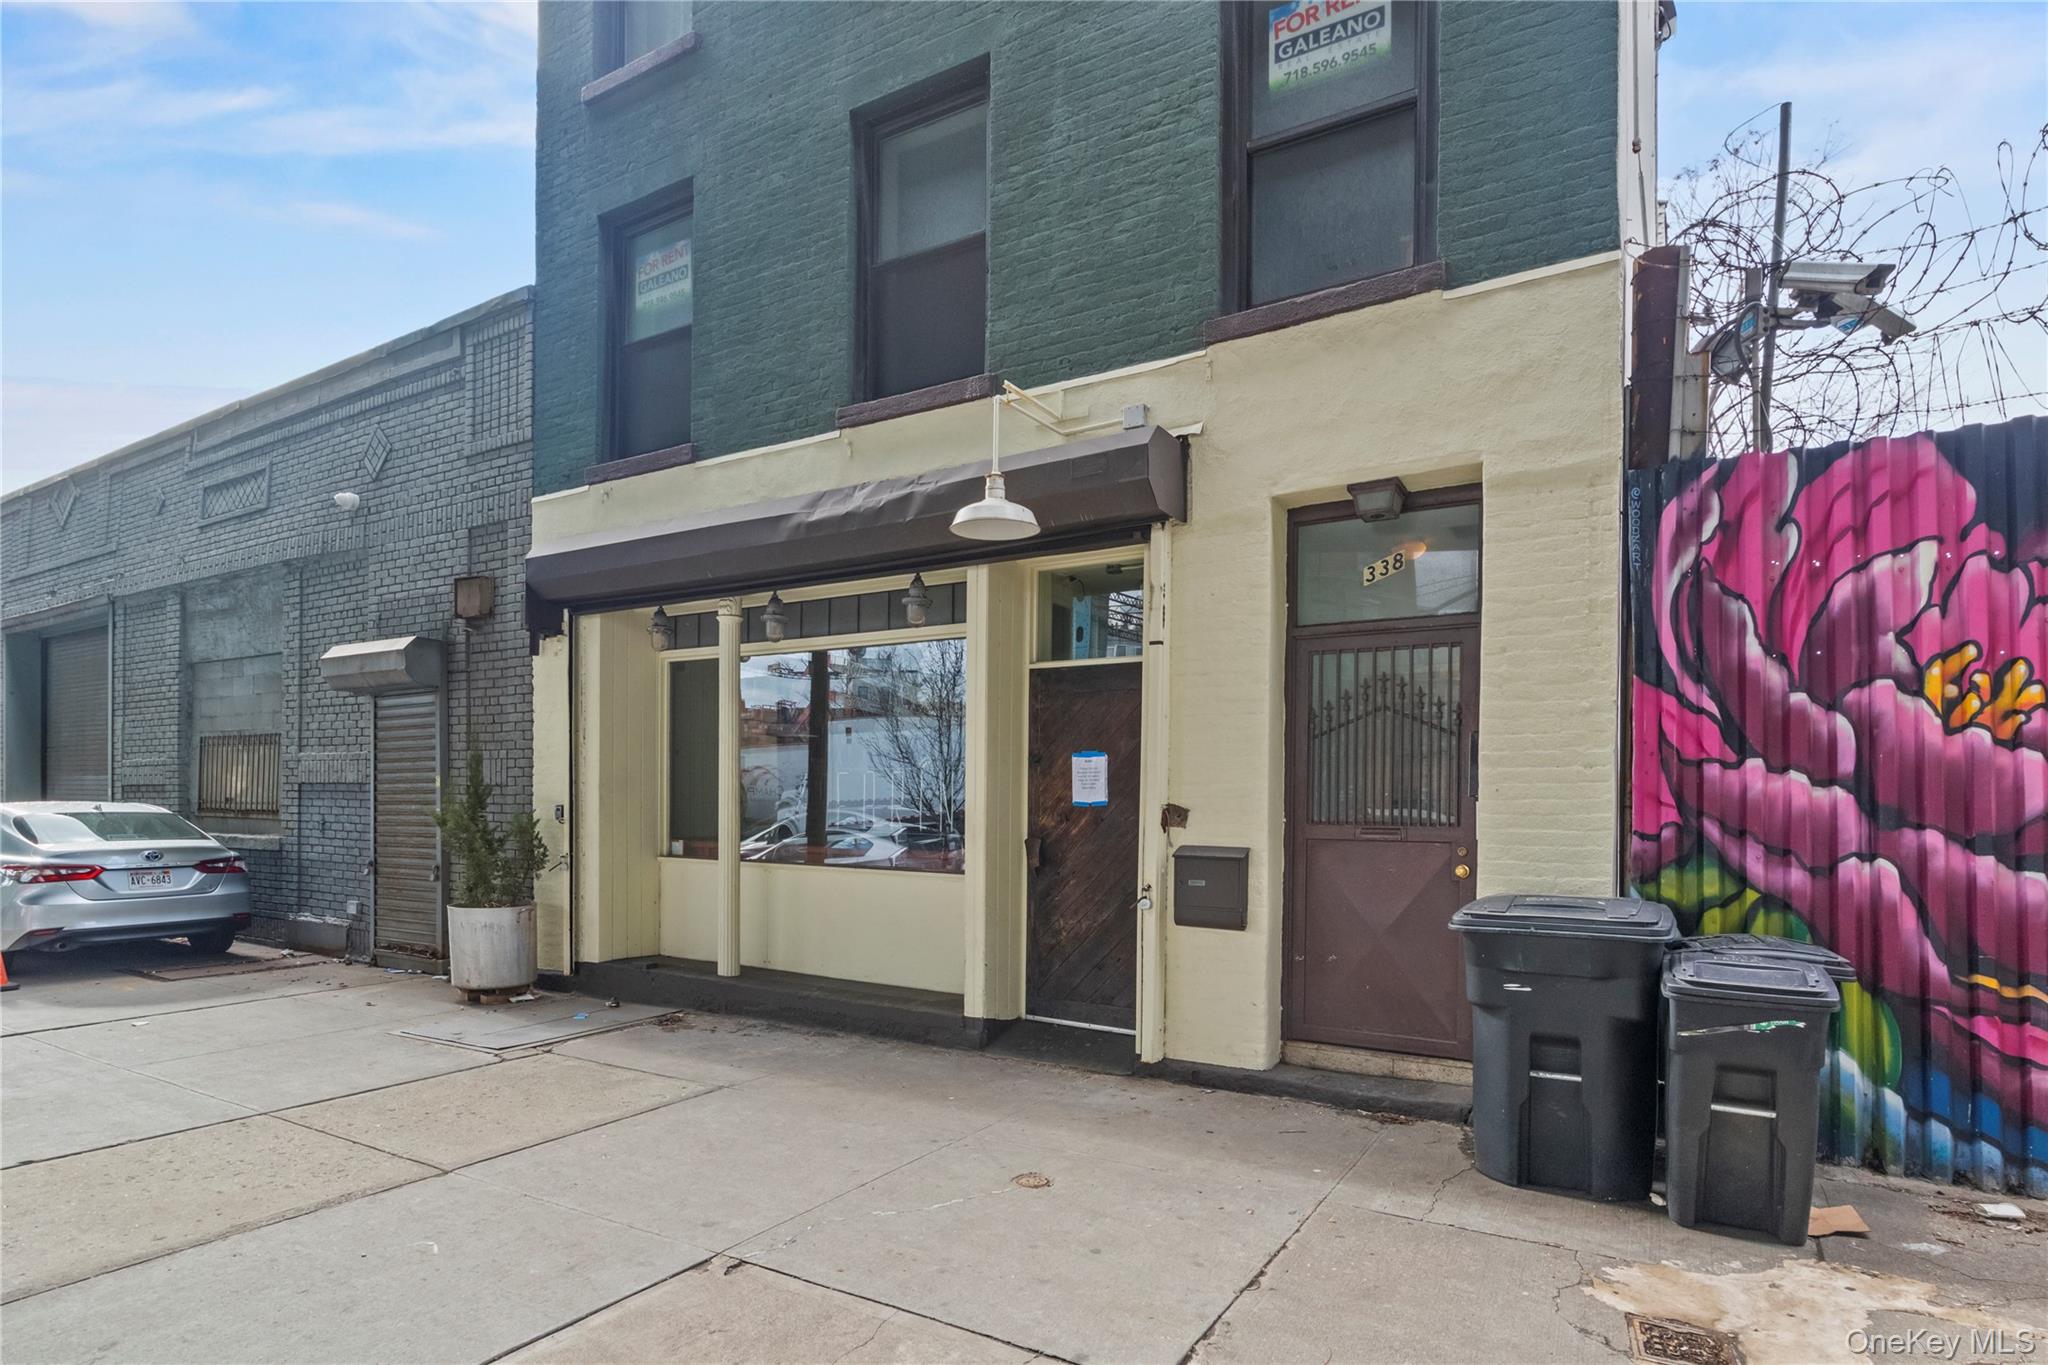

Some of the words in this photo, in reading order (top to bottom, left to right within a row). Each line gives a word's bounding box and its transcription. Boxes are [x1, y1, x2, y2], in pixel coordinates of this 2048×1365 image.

[1273, 5, 1320, 40] FOR
[1278, 11, 1381, 59] GALEANO
[1284, 43, 1377, 85] 718.596.9545
[639, 258, 659, 278] FOR
[662, 246, 689, 267] RENT
[639, 266, 687, 293] GALEANO
[1365, 552, 1404, 583] 338
